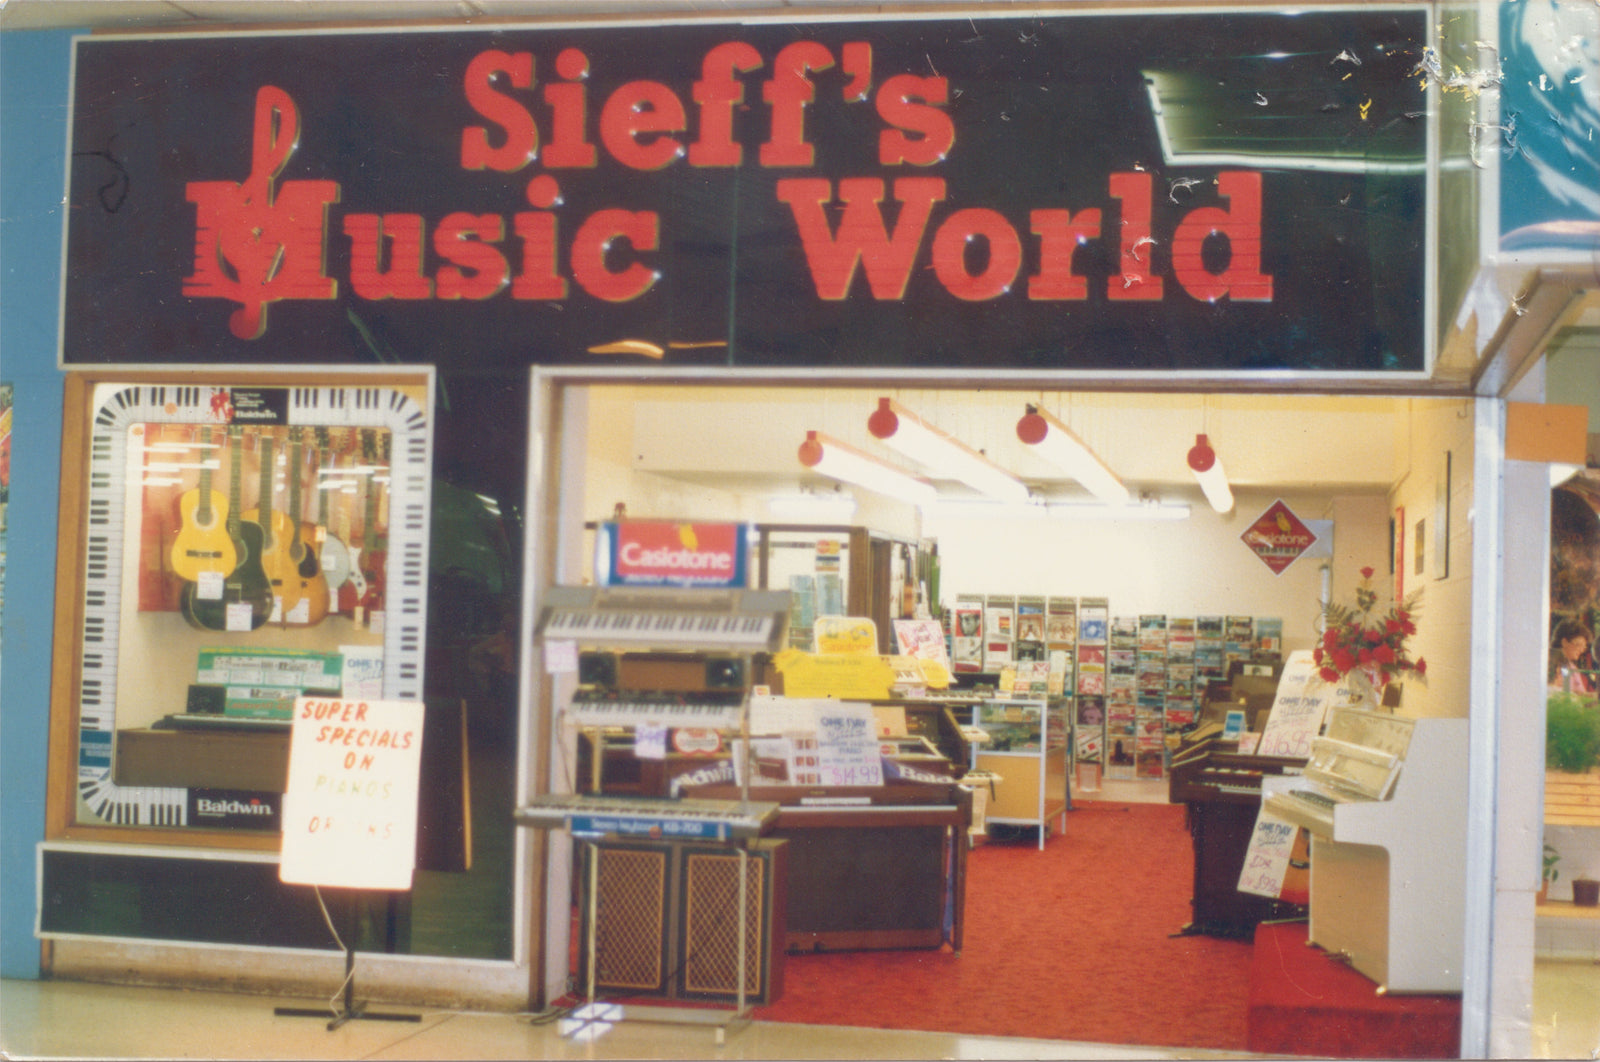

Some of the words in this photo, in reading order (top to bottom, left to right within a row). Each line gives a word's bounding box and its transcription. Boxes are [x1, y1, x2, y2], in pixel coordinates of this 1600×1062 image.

[461, 41, 956, 172] Sieff's
[182, 174, 661, 303] Music
[777, 171, 1274, 303] World
[621, 542, 731, 569] Casiotone
[301, 700, 369, 722] SUPER
[315, 725, 413, 750] SPECIALS
[343, 751, 374, 771] ON
[313, 774, 393, 800] PIANOS
[197, 798, 272, 815] Baldwin
